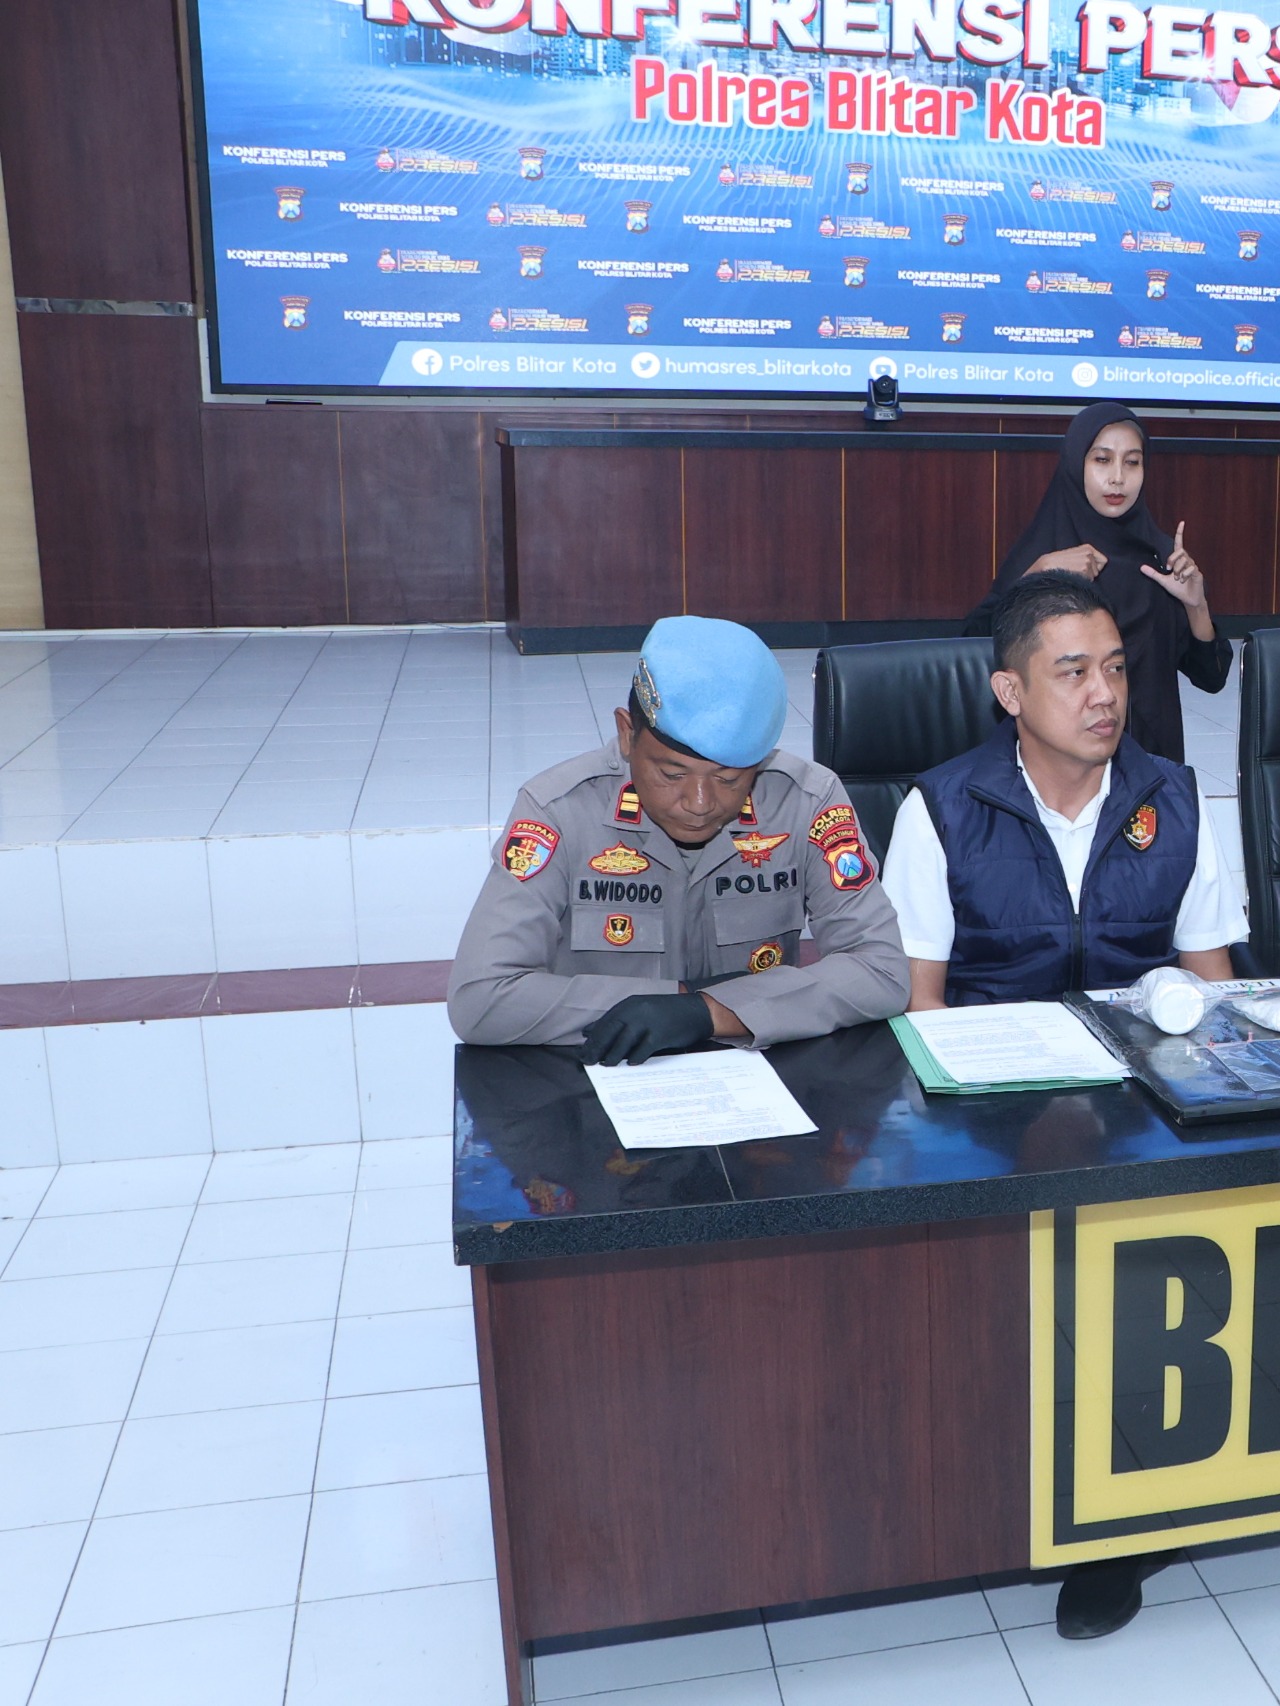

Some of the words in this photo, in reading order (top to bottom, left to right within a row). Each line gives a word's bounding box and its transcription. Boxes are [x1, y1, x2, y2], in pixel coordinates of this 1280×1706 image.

[364, 0, 1048, 68] ERENSI
[633, 58, 811, 129] Polres
[827, 69, 975, 137] Blitar
[988, 81, 1103, 146] Kota
[223, 146, 309, 160] KONFERENSI
[310, 149, 346, 161] PERS
[579, 163, 657, 175] KONFERENSI
[658, 166, 690, 176] PERS
[901, 177, 974, 190] KONFERENSI
[974, 181, 1004, 191] PERS
[969, 189, 988, 197] KOTA
[1201, 195, 1267, 208] KONFERENSI
[340, 203, 423, 215] KONFERENSI
[424, 206, 458, 216] PERS
[683, 215, 760, 227] KONFERENSI
[761, 218, 792, 228] PERS
[996, 228, 1066, 241] KONFERENSI
[1067, 231, 1096, 242] PERS
[227, 250, 312, 262] KONFERENSI
[313, 252, 348, 263] PERS
[578, 260, 656, 272] KONFERENSI
[657, 262, 689, 273] PERS
[898, 270, 970, 282] KONFERENSI
[971, 273, 1000, 283] PERS
[1196, 284, 1262, 296] KONFERENSI
[344, 311, 426, 322] KONFERENSI
[427, 313, 460, 322] PERS
[683, 318, 760, 329] KONFERENSI
[761, 319, 792, 329] PERS
[994, 326, 1064, 337] KONFERENSI
[1065, 328, 1094, 338] PERS
[449, 355, 510, 373] Polres
[516, 355, 566, 374] Blitar
[572, 357, 617, 375] Kota
[665, 358, 852, 378] humasres_blitarkota
[904, 362, 959, 381] Polres
[964, 364, 1009, 382] Blitar
[1014, 366, 1055, 383] Kota
[809, 807, 851, 839] POLRES
[516, 823, 556, 842] PROPAM
[715, 868, 798, 897] POLRI
